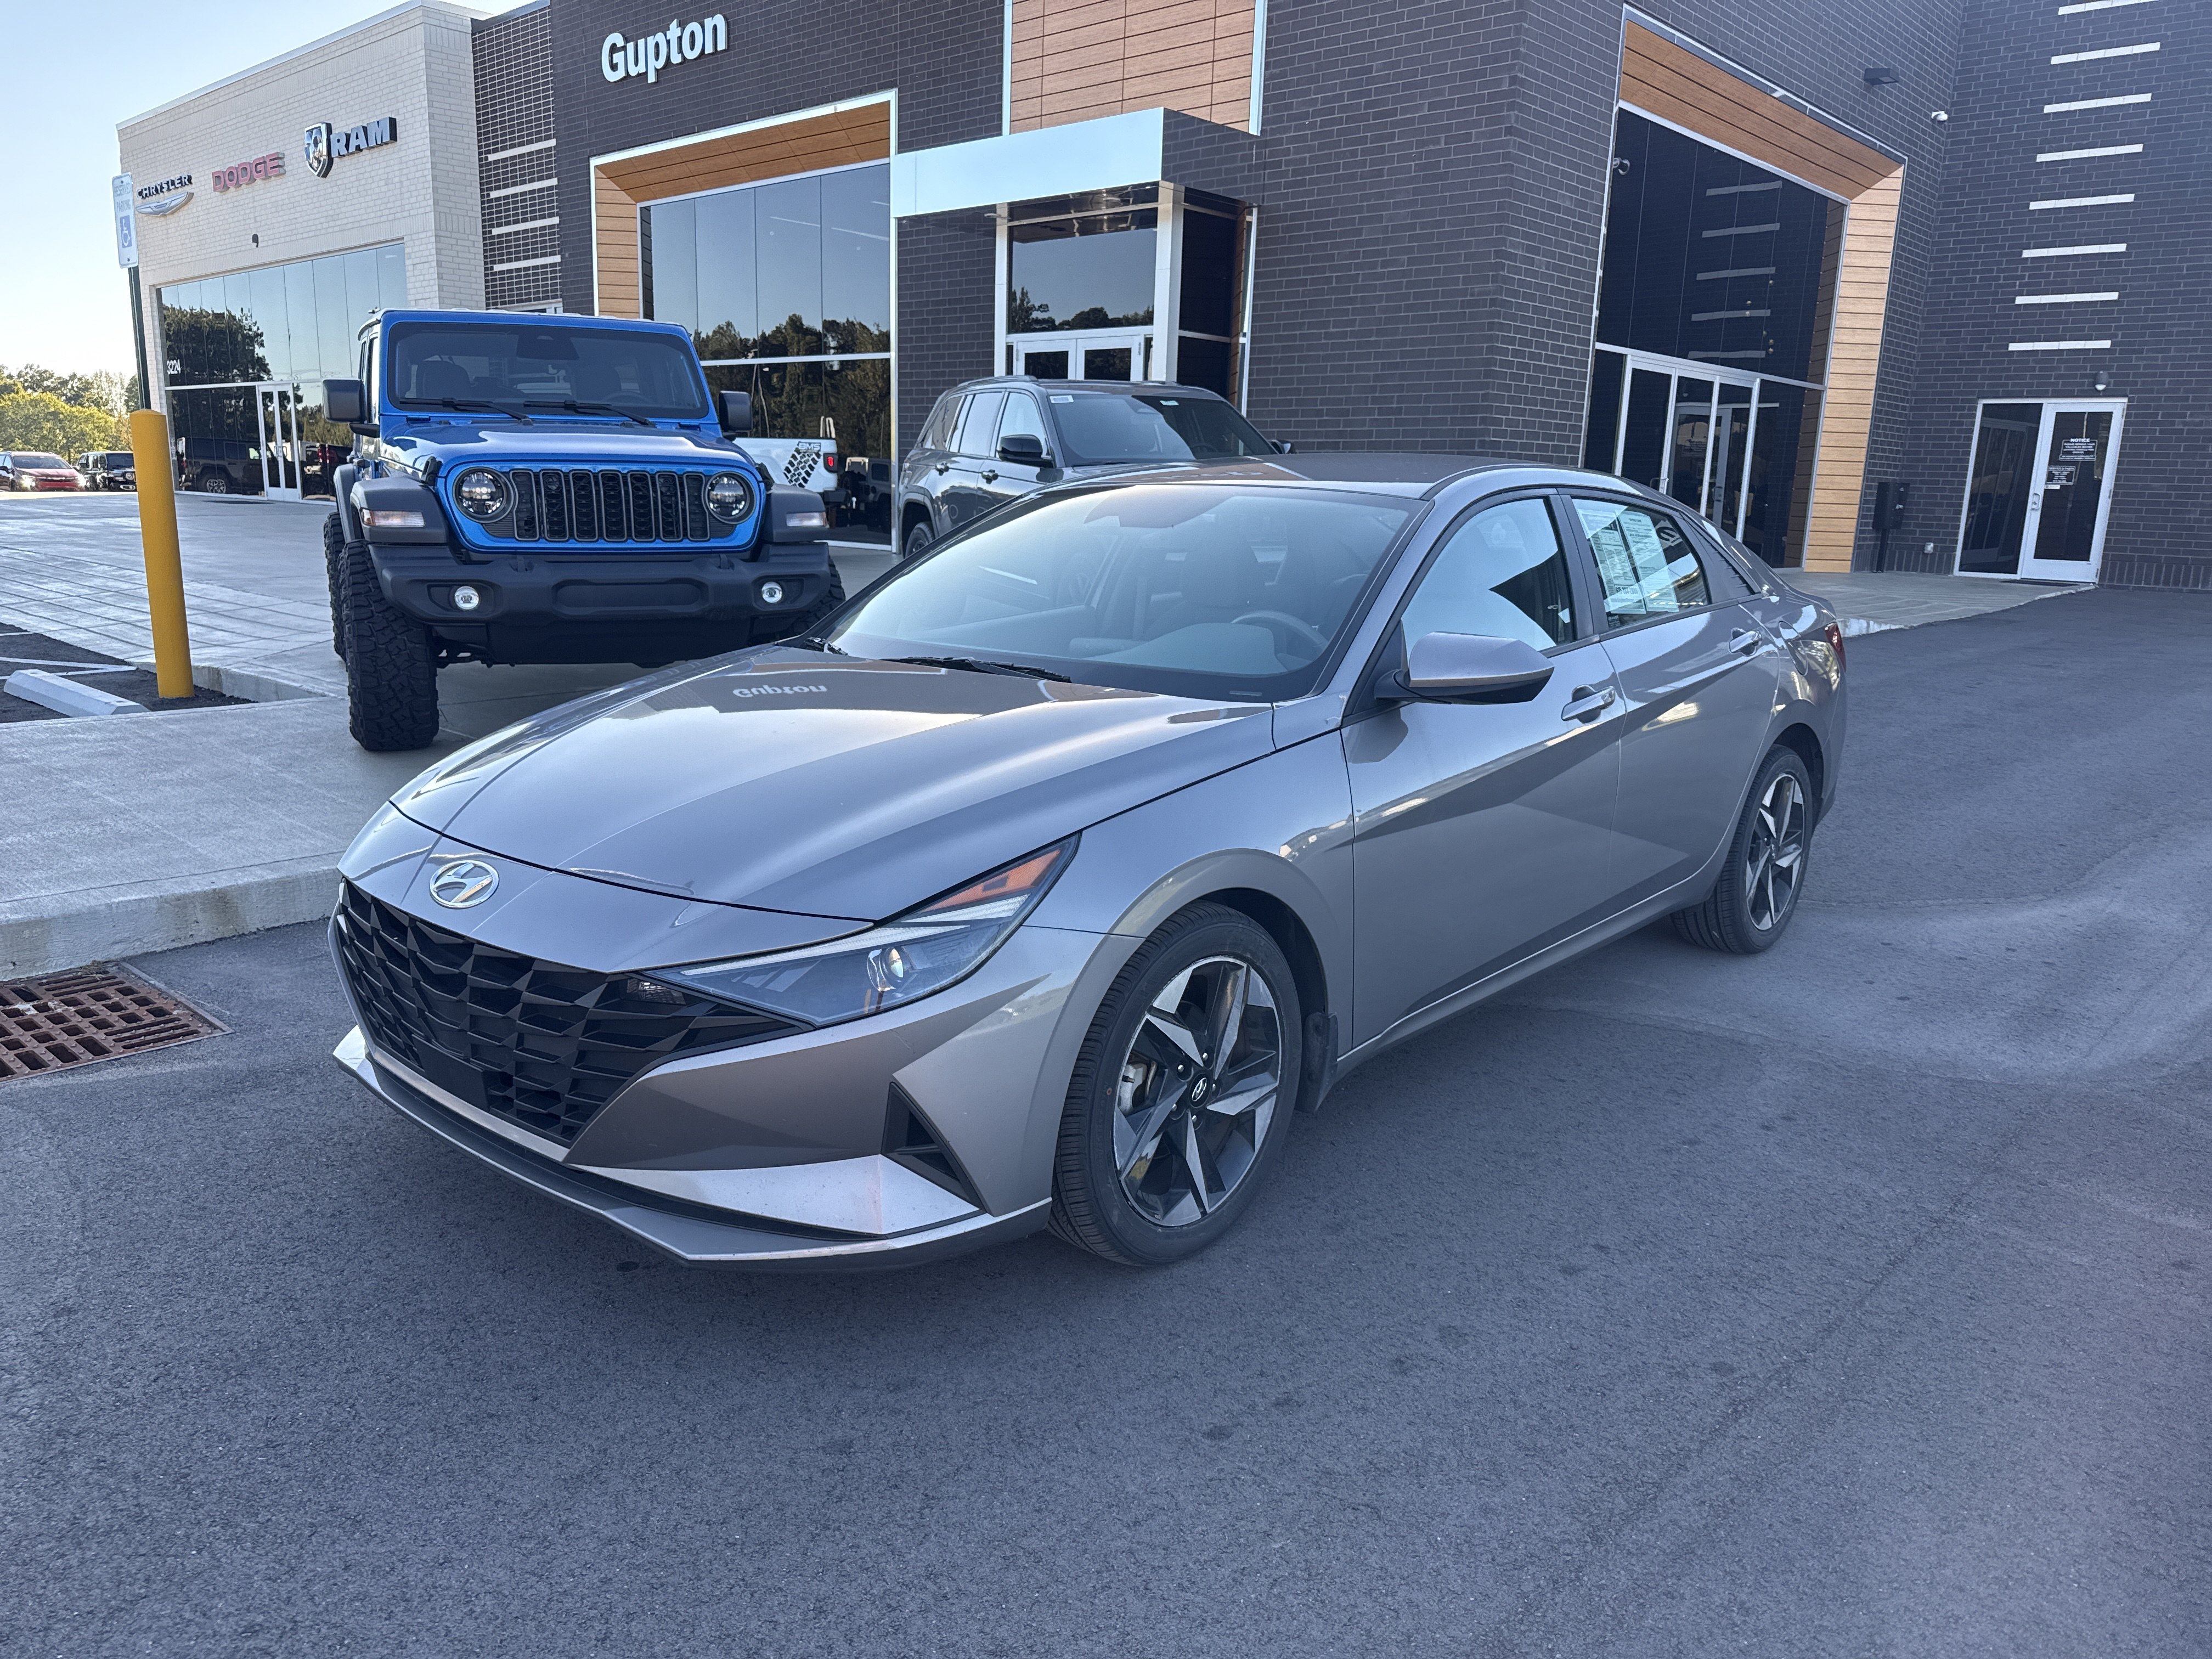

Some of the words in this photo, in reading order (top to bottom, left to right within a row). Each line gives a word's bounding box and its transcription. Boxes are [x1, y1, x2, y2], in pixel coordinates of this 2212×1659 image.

[601, 14, 727, 83] Gupton
[330, 117, 395, 158] RAM
[137, 175, 191, 200] CHRYSLER
[212, 152, 284, 192] DODGE
[166, 359, 181, 374] 3224
